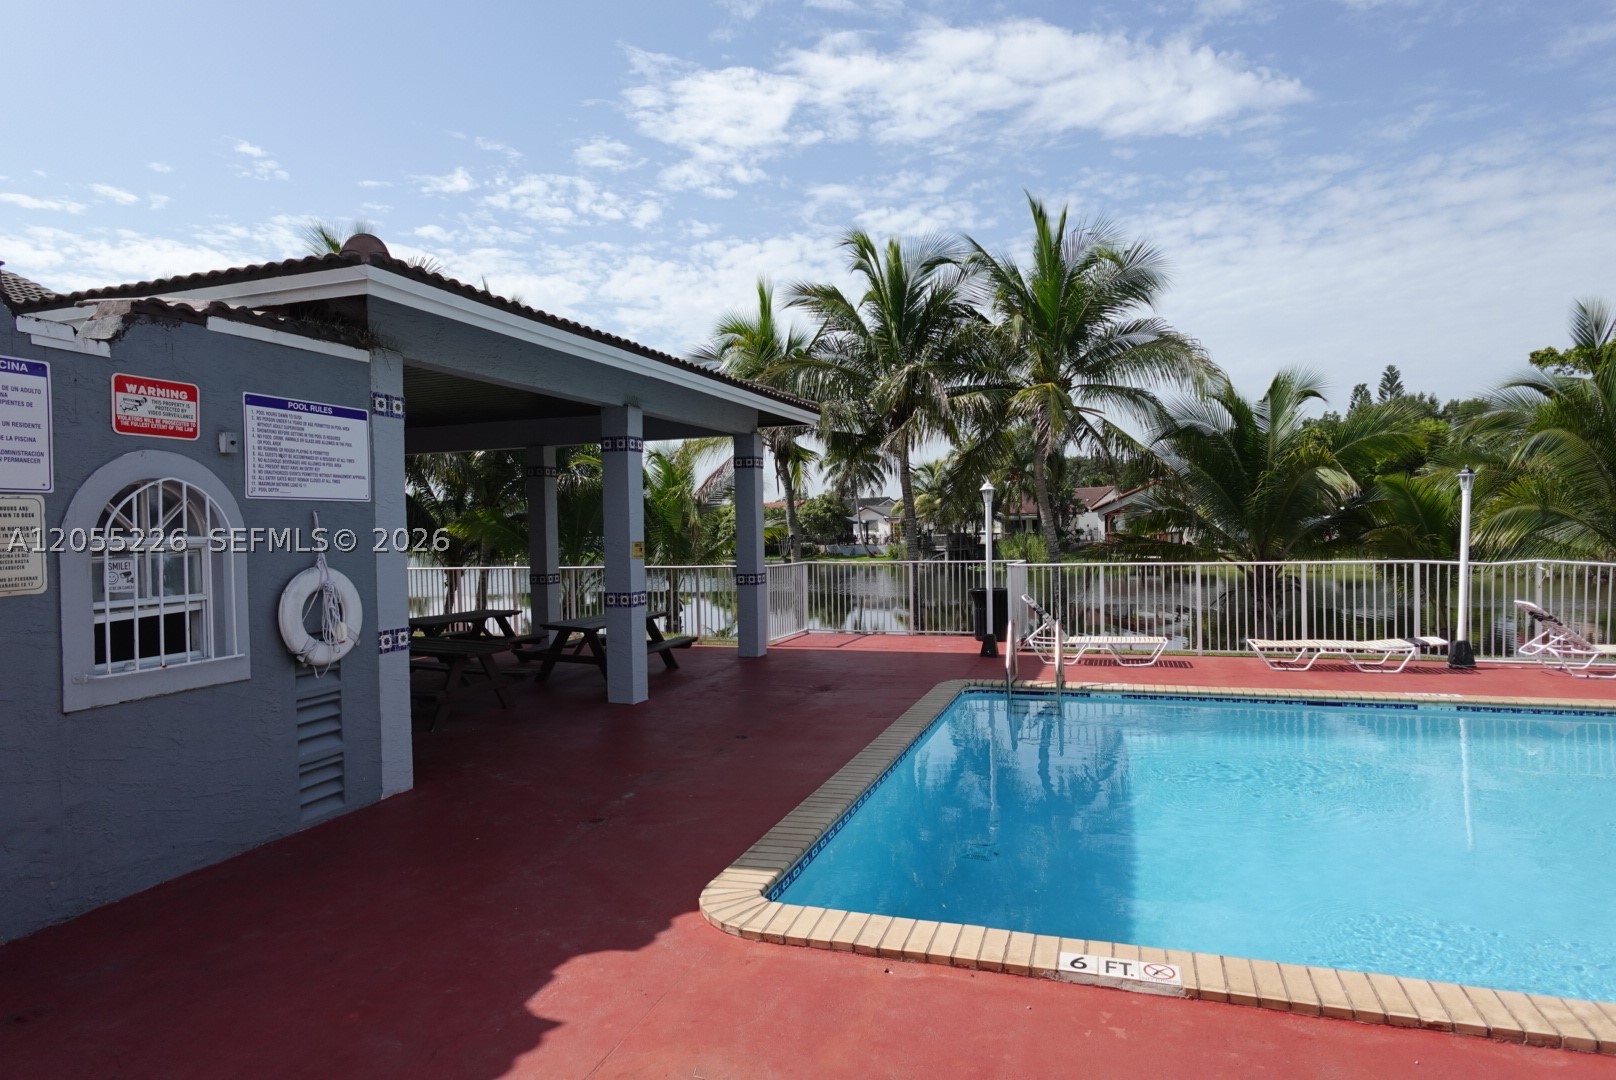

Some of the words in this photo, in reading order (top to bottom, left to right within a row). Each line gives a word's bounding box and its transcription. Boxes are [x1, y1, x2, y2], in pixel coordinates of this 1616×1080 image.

[125, 384, 188, 400] WARNING
[288, 401, 308, 411] POOL
[310, 405, 332, 414] RULES
[108, 561, 130, 570] SMILE!
[1070, 957, 1087, 970] 6
[1105, 960, 1134, 977] FT.
